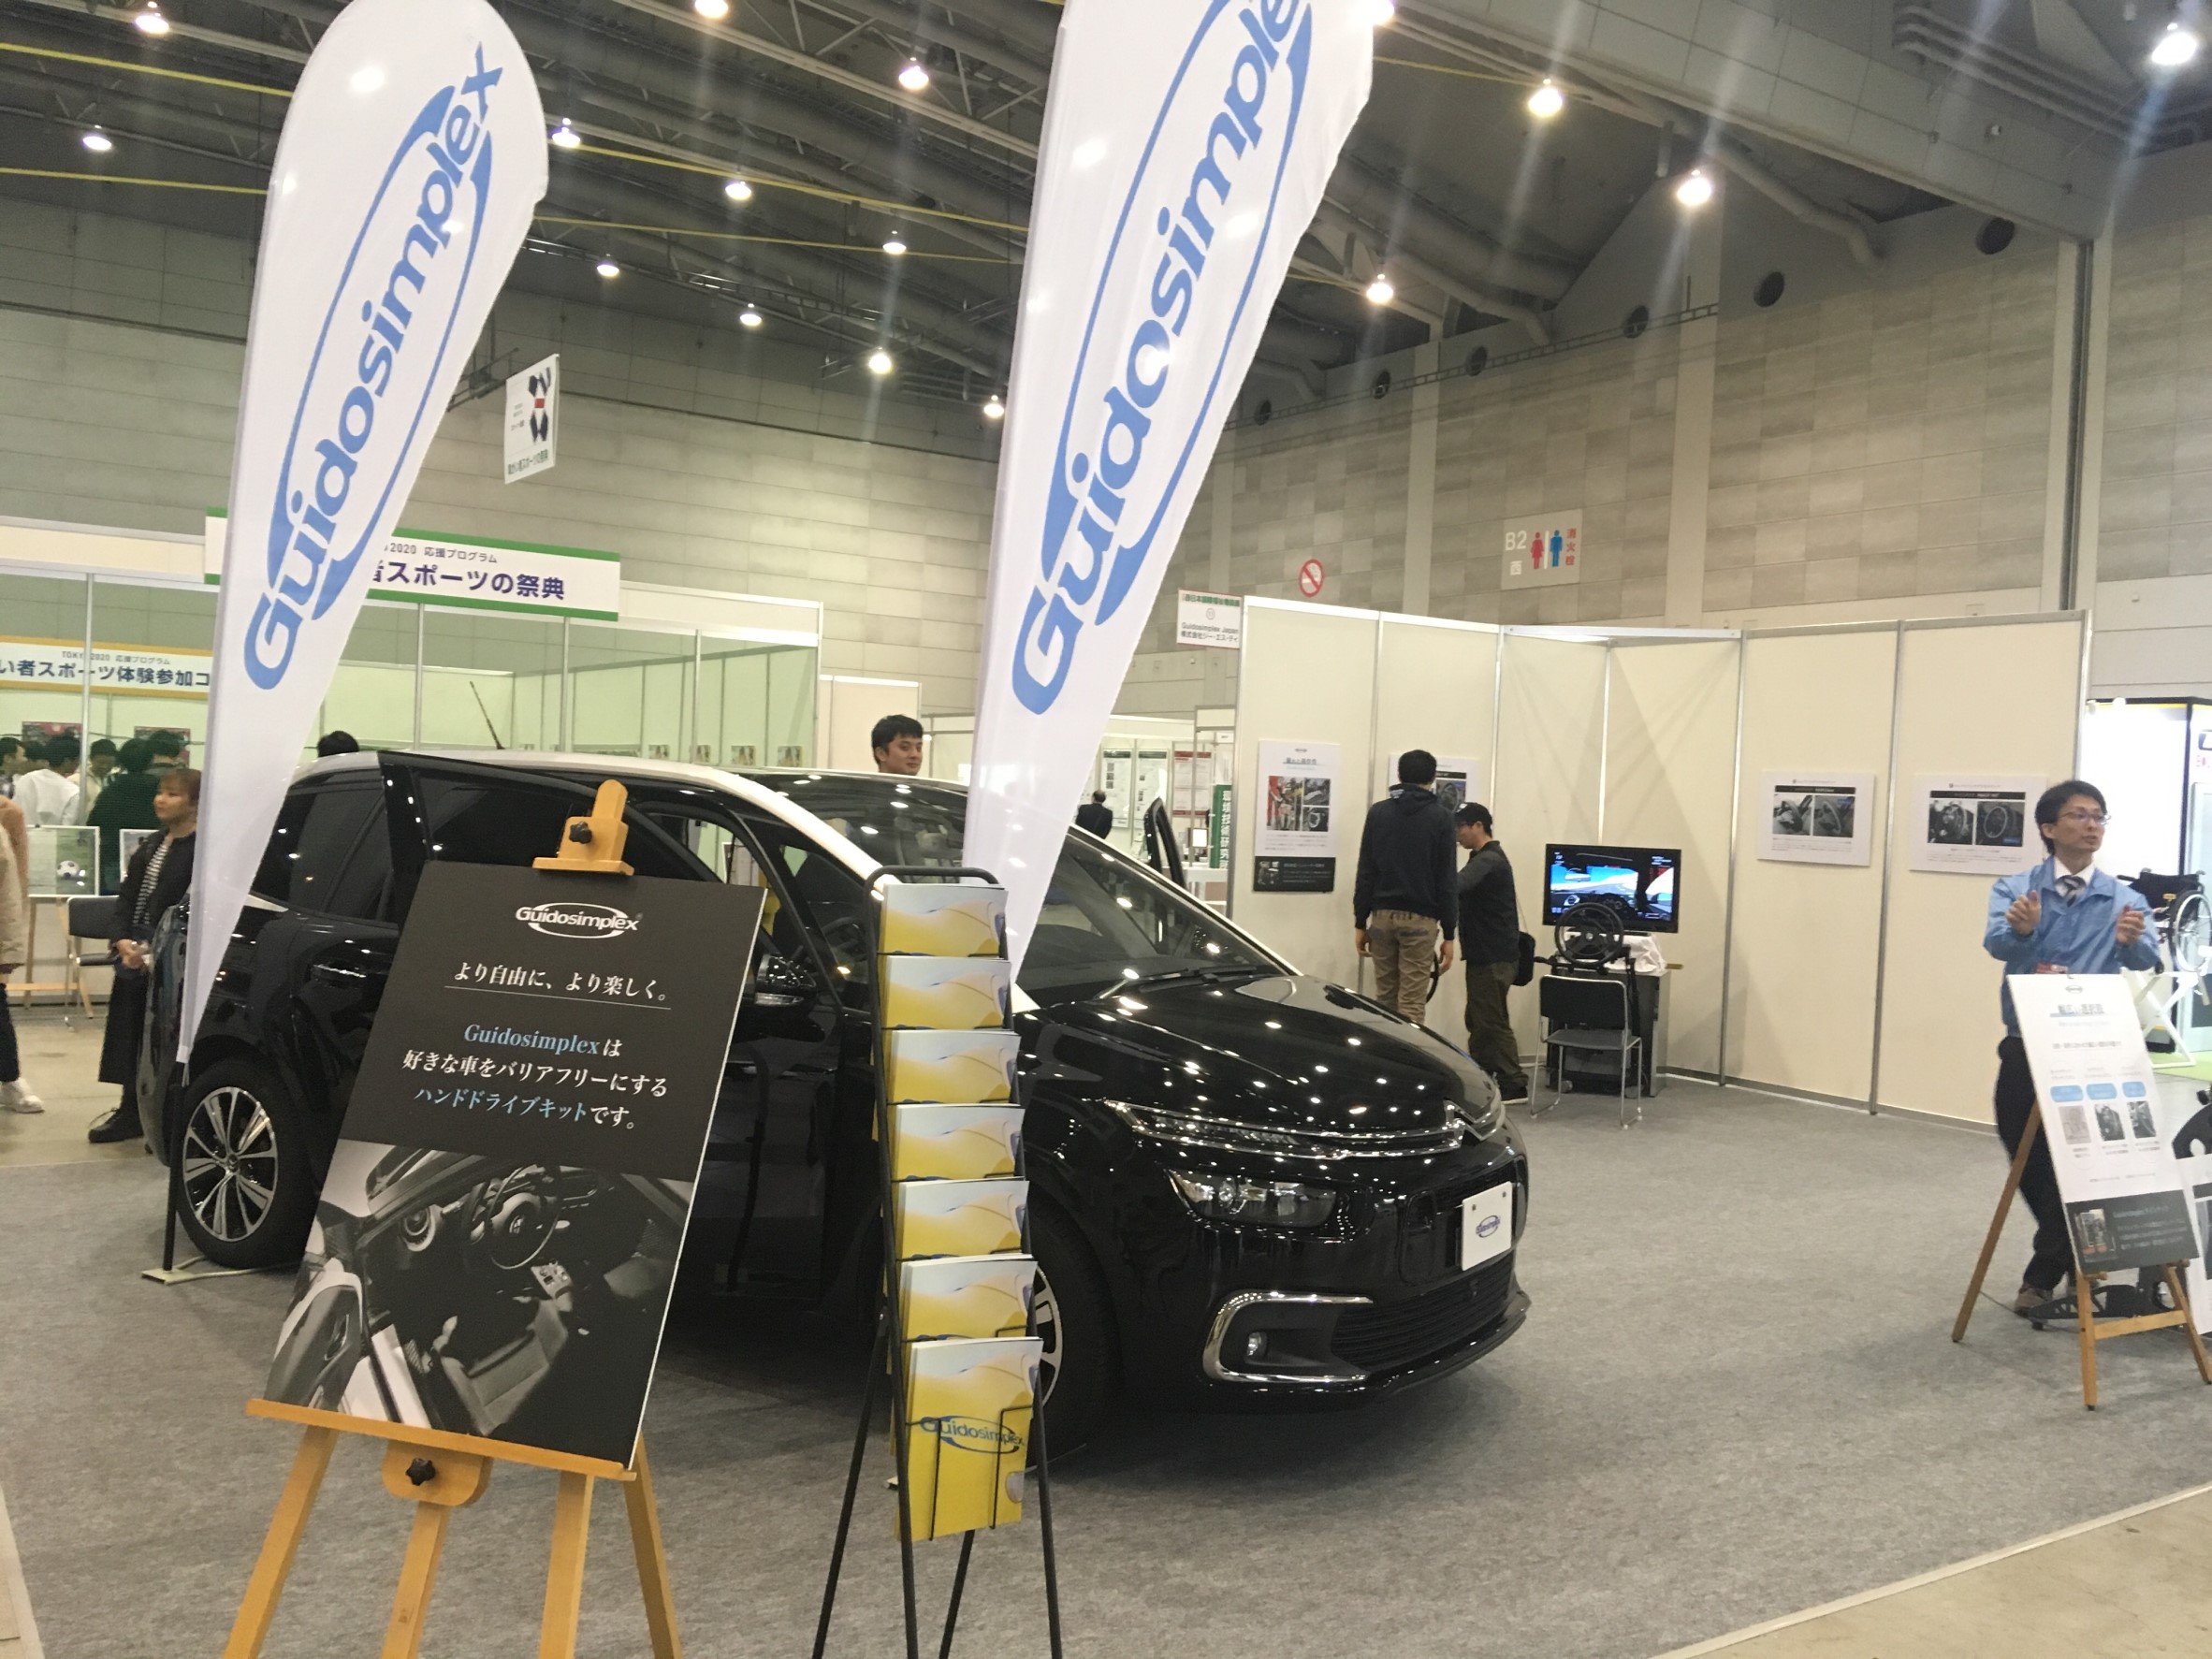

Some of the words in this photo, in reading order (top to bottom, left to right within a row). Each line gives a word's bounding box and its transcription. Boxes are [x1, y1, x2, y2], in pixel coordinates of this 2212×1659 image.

[244, 41, 502, 690] Guidosimplex
[1012, 0, 1301, 715] Guidosimple
[390, 542, 417, 556] 2020
[424, 546, 498, 564] 応援プログラム
[1506, 530, 1527, 551] B2
[516, 906, 639, 932] Guidosimplex
[454, 962, 667, 1002] より自由に、より楽しく。
[401, 1050, 668, 1099] 好きな車をバリアフリーにする
[414, 1087, 634, 1130] ハンドドライブキットです。
